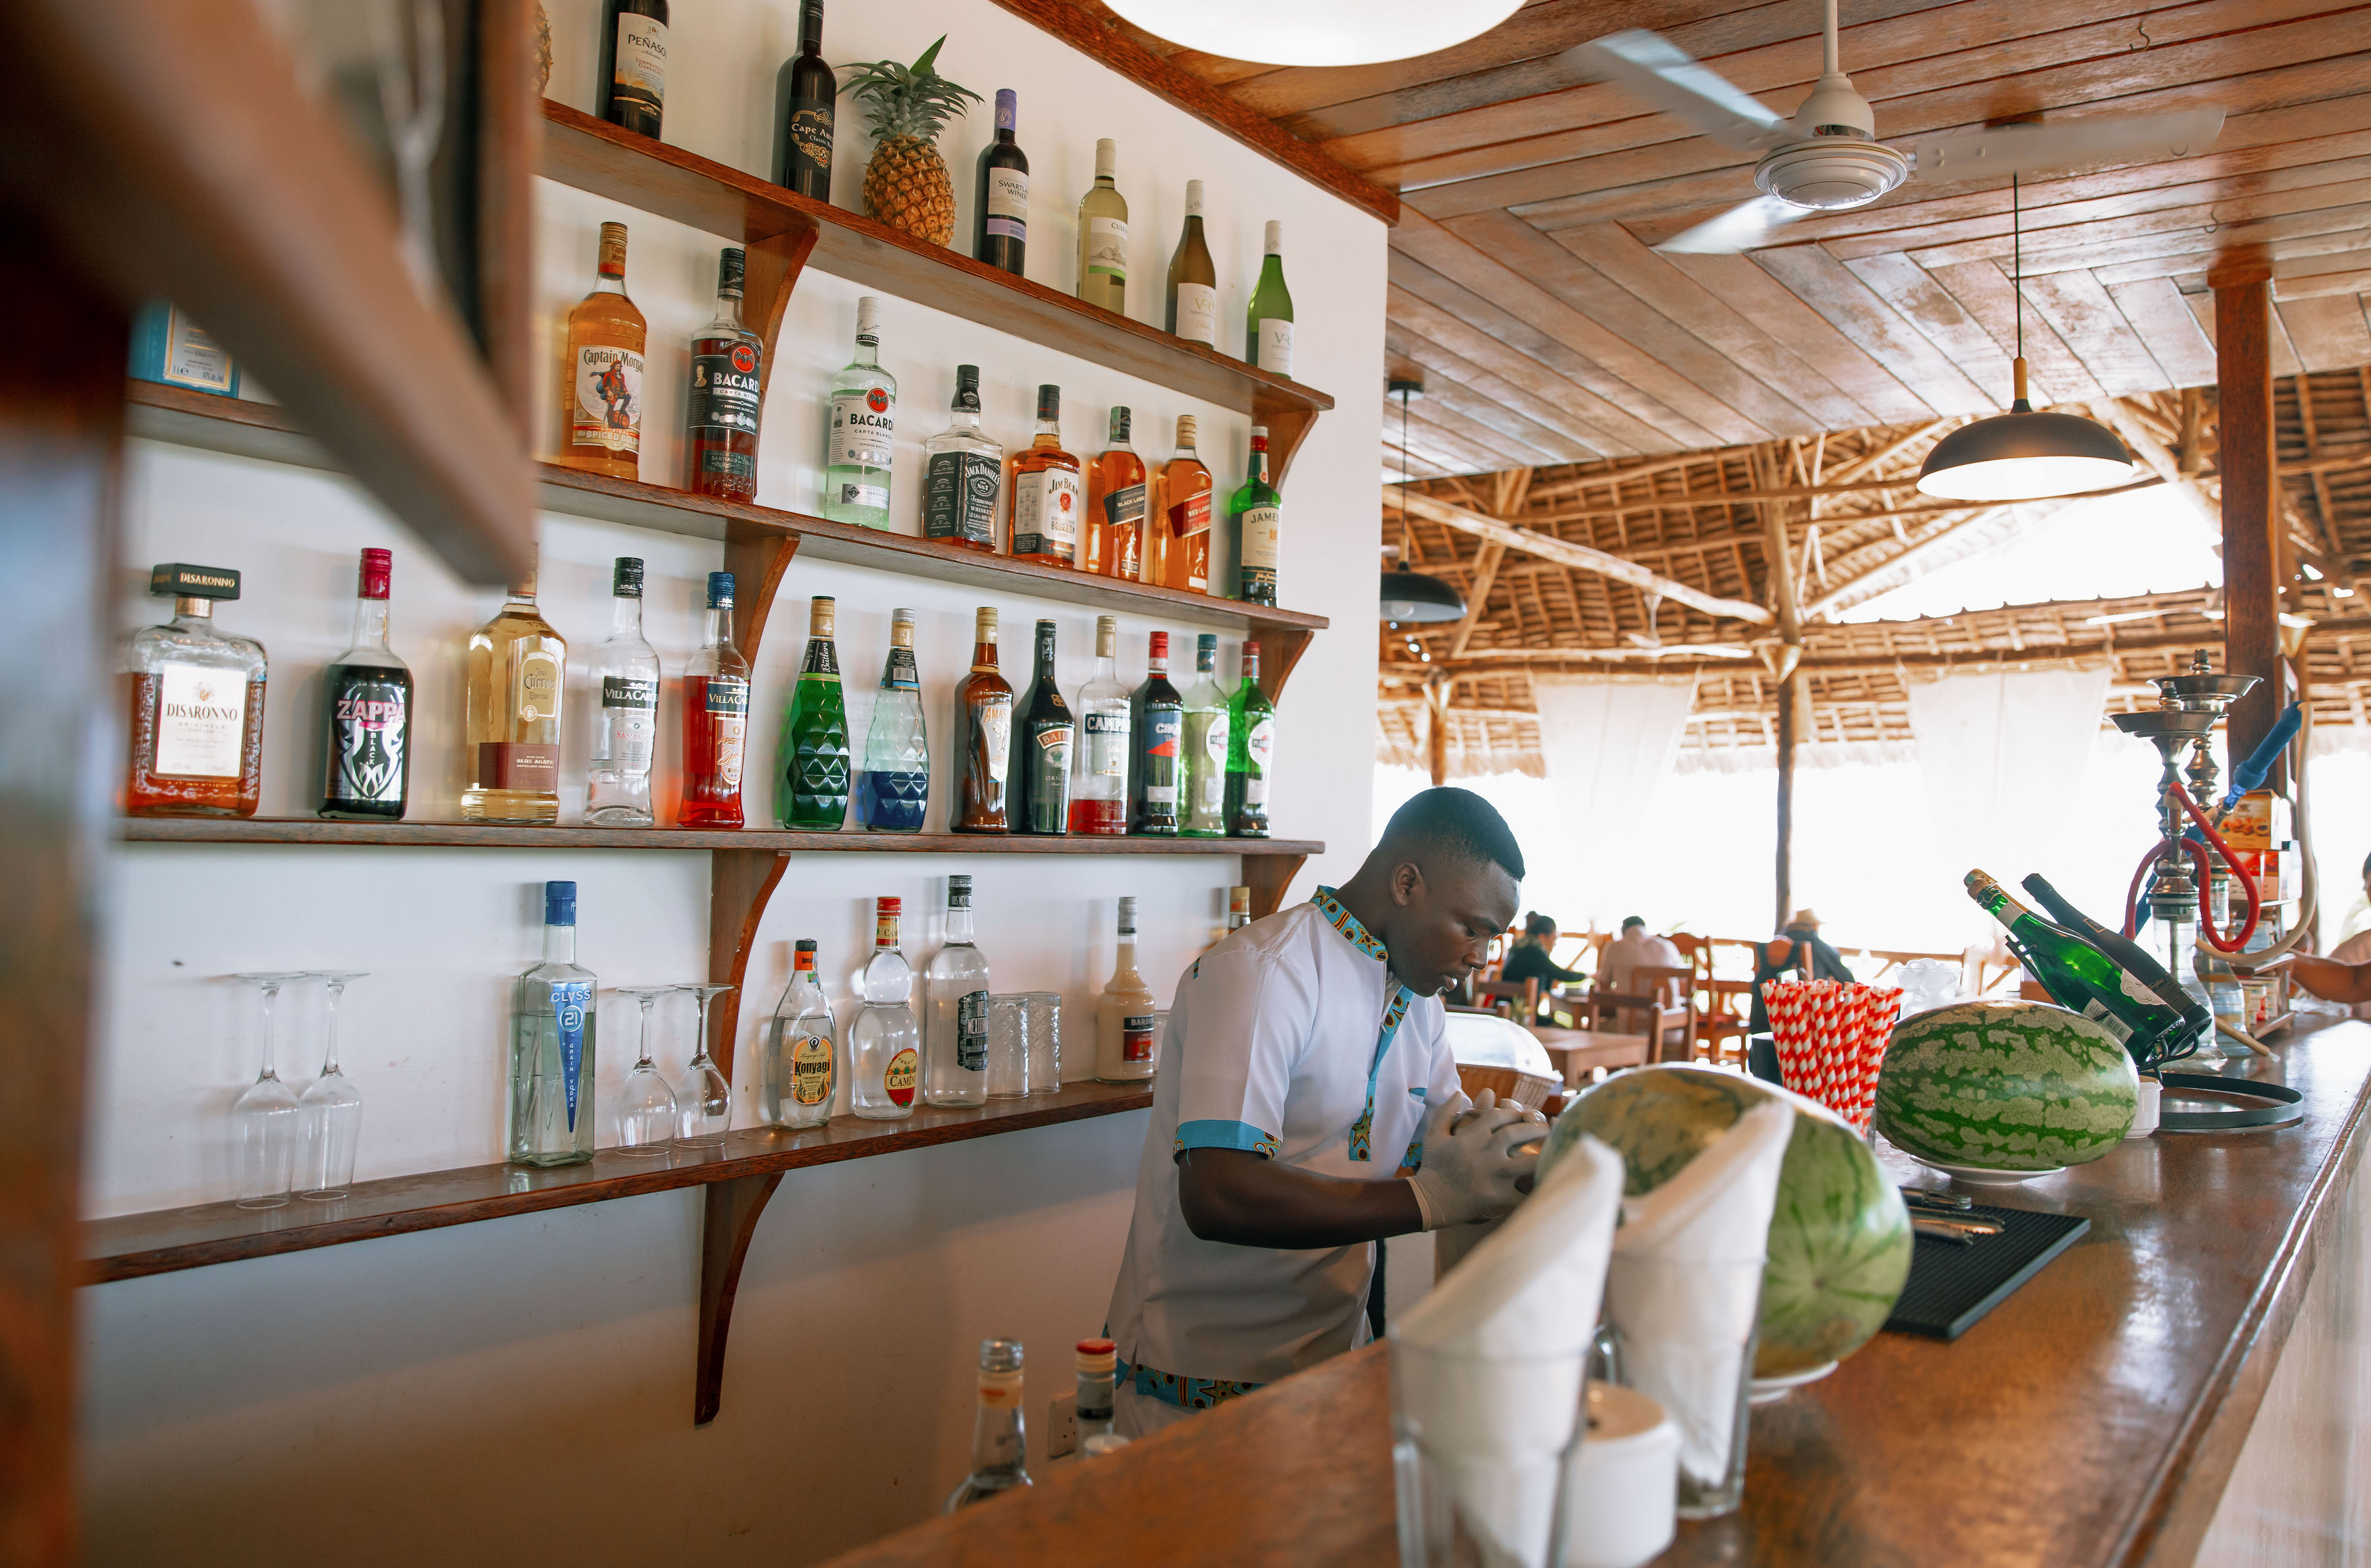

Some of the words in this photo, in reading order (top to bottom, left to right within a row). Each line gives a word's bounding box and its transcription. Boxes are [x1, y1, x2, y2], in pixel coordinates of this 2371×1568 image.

[792, 123, 817, 134] Cape
[809, 135, 827, 145] Classic
[584, 349, 618, 365] Captain
[586, 431, 619, 441] SPICED
[621, 435, 637, 446] GOLD
[966, 465, 980, 478] JACK
[980, 463, 1000, 485] DANIEL'S
[1049, 479, 1063, 494] JIM
[970, 506, 993, 515] WHISKEY
[180, 572, 235, 587] DISARONNO
[524, 674, 555, 689] Cuervo
[530, 691, 549, 700] Especial
[167, 703, 238, 721] DISARONNO
[337, 700, 406, 723] ZAPPA
[564, 1012, 578, 1026] 21
[794, 1059, 830, 1077] Konyagi
